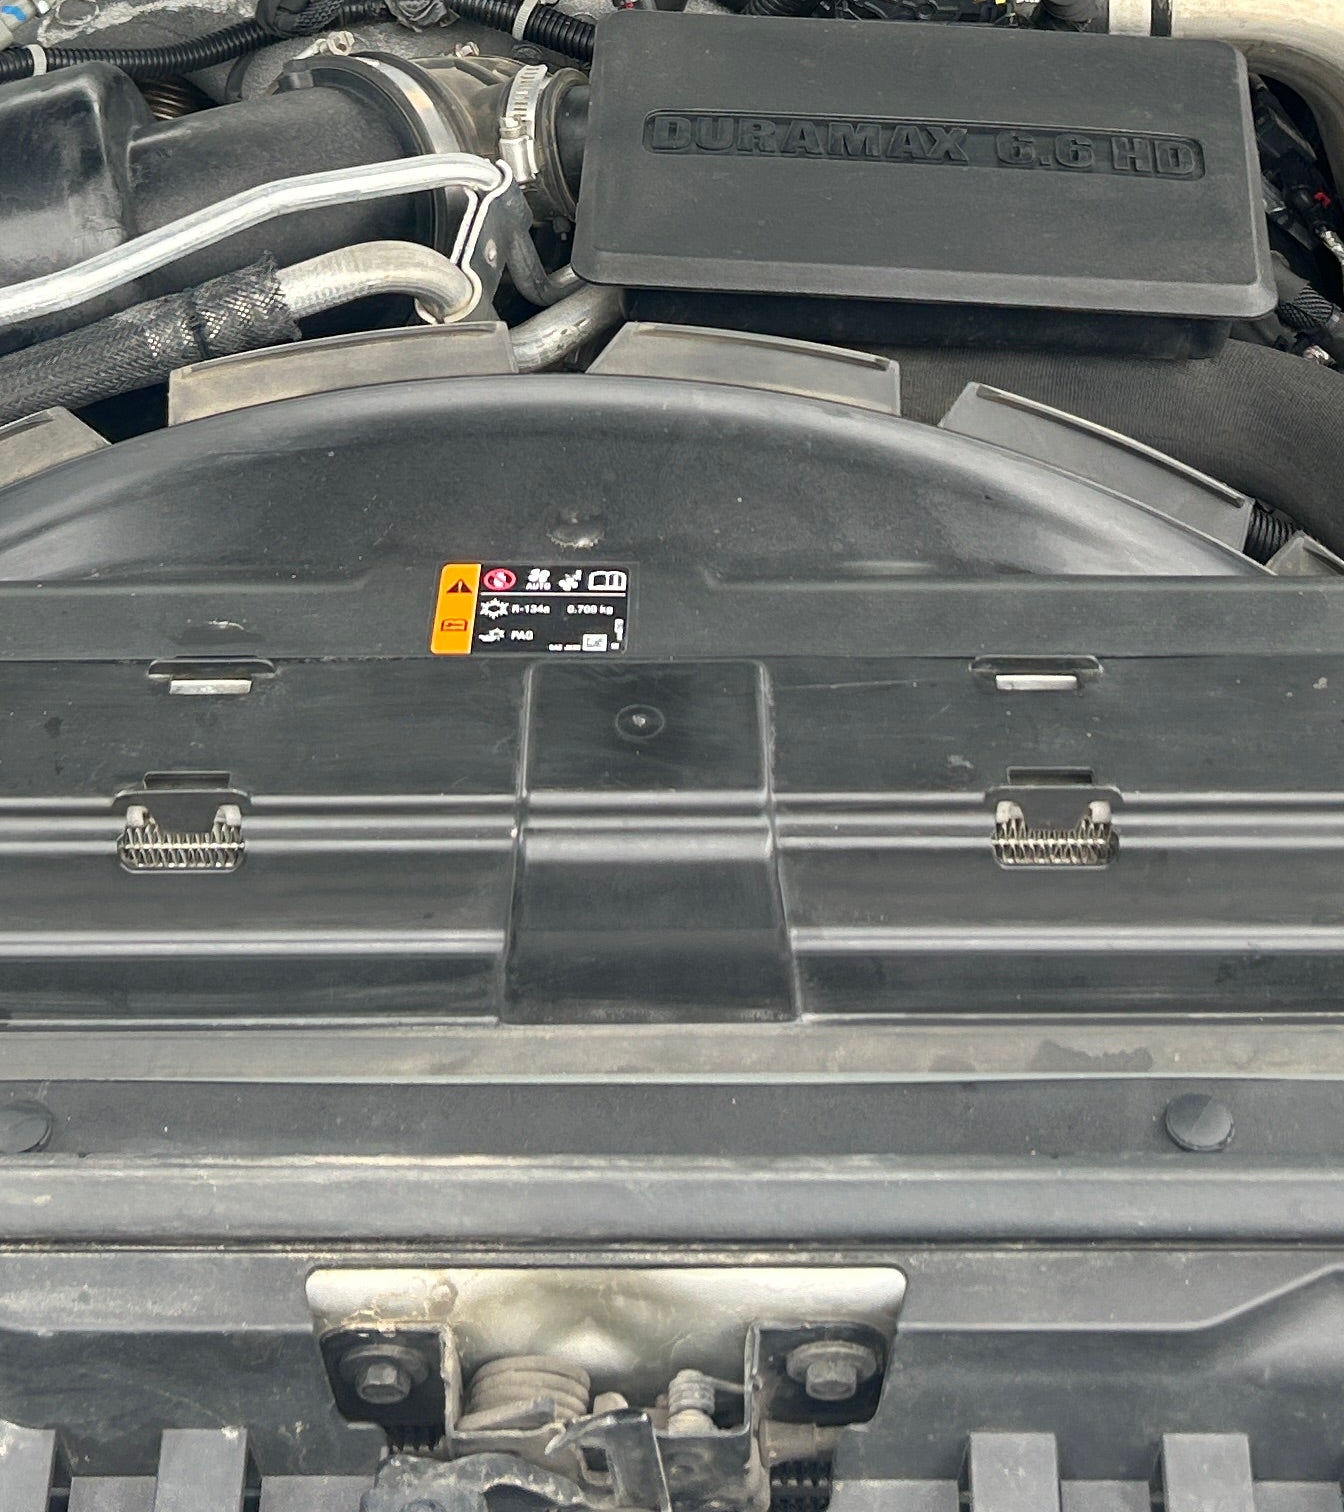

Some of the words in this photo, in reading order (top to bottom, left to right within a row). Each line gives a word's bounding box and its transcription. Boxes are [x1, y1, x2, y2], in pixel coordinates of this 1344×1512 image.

[650, 116, 969, 165] DURAMAX
[996, 131, 1095, 168] 6.6
[1111, 137, 1195, 175] HD
[526, 582, 551, 590] AUTO
[512, 604, 550, 614] R-134a
[600, 604, 613, 616] kg
[511, 630, 533, 640] PAG
